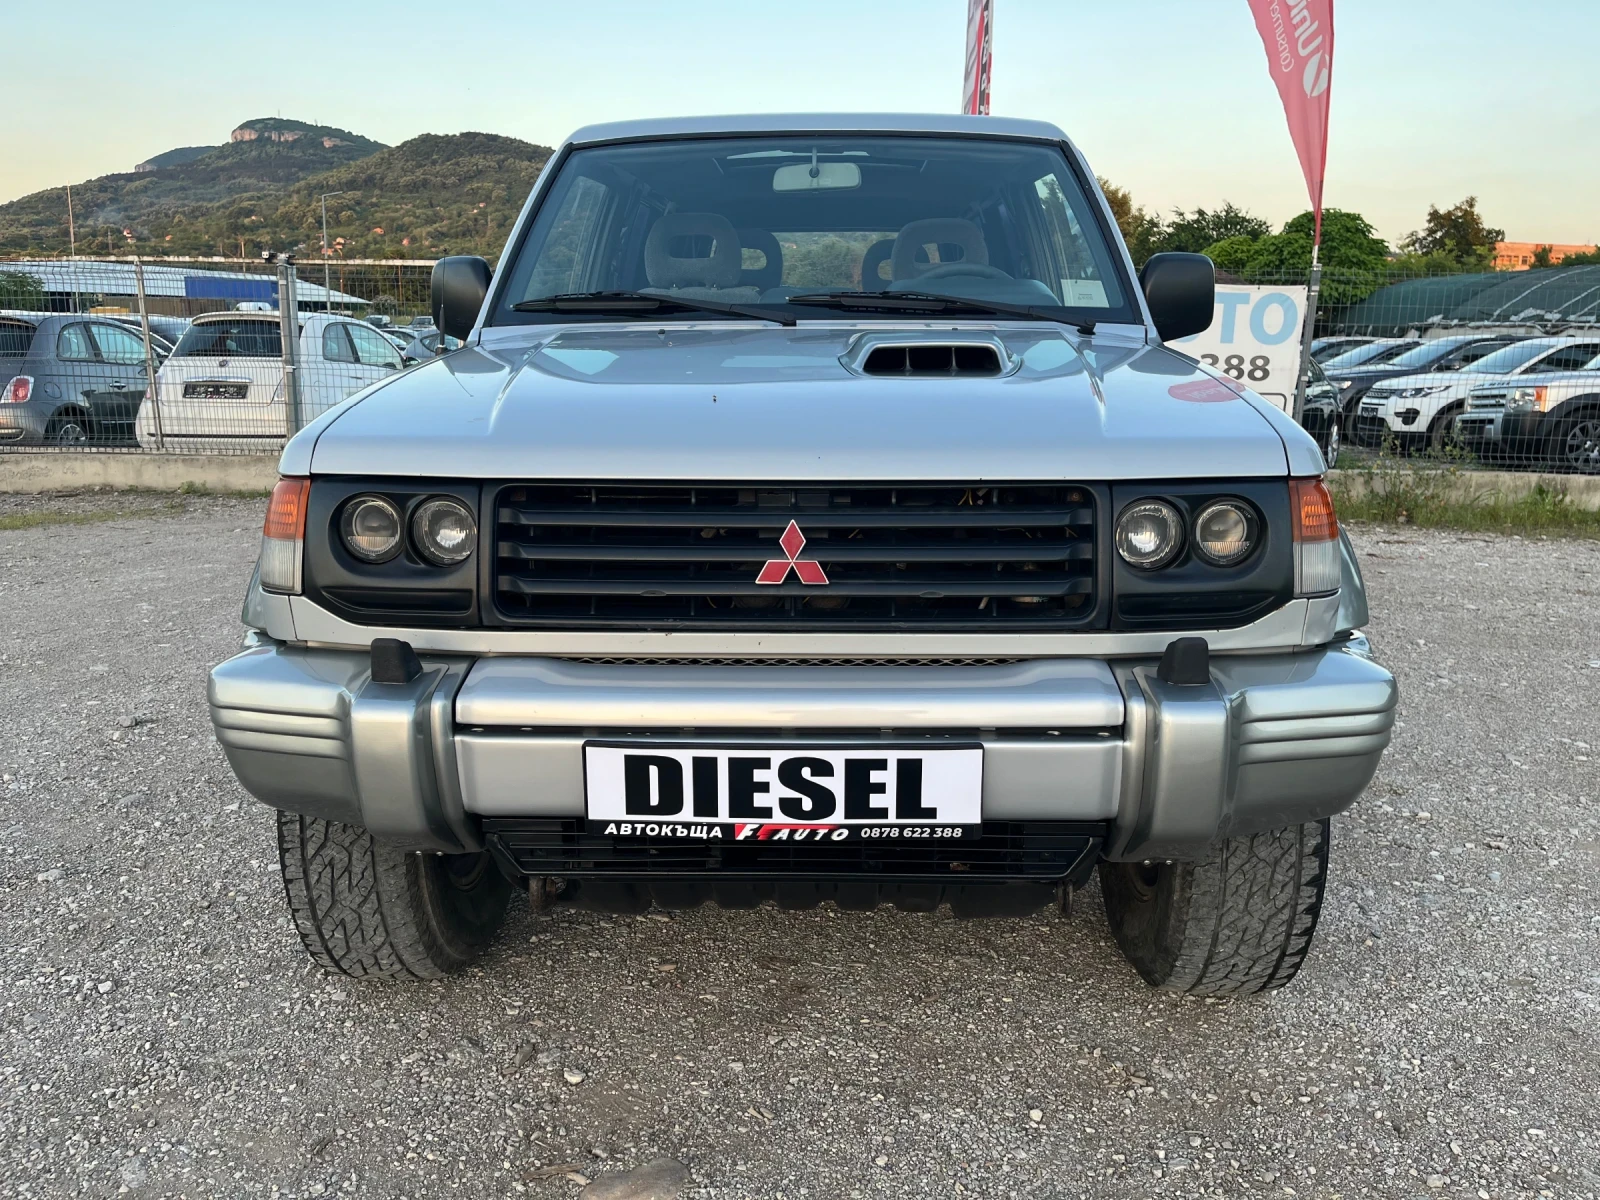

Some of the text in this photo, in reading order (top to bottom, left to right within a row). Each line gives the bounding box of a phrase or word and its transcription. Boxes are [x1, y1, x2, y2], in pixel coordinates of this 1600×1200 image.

[1174, 292, 1298, 346] TO
[624, 754, 938, 821] DIESEL
[603, 822, 723, 839] АВТОКЪЩА
[772, 827, 849, 840] AUTO
[860, 827, 900, 838] 0878
[903, 827, 930, 838] 622
[932, 827, 962, 838] 388
